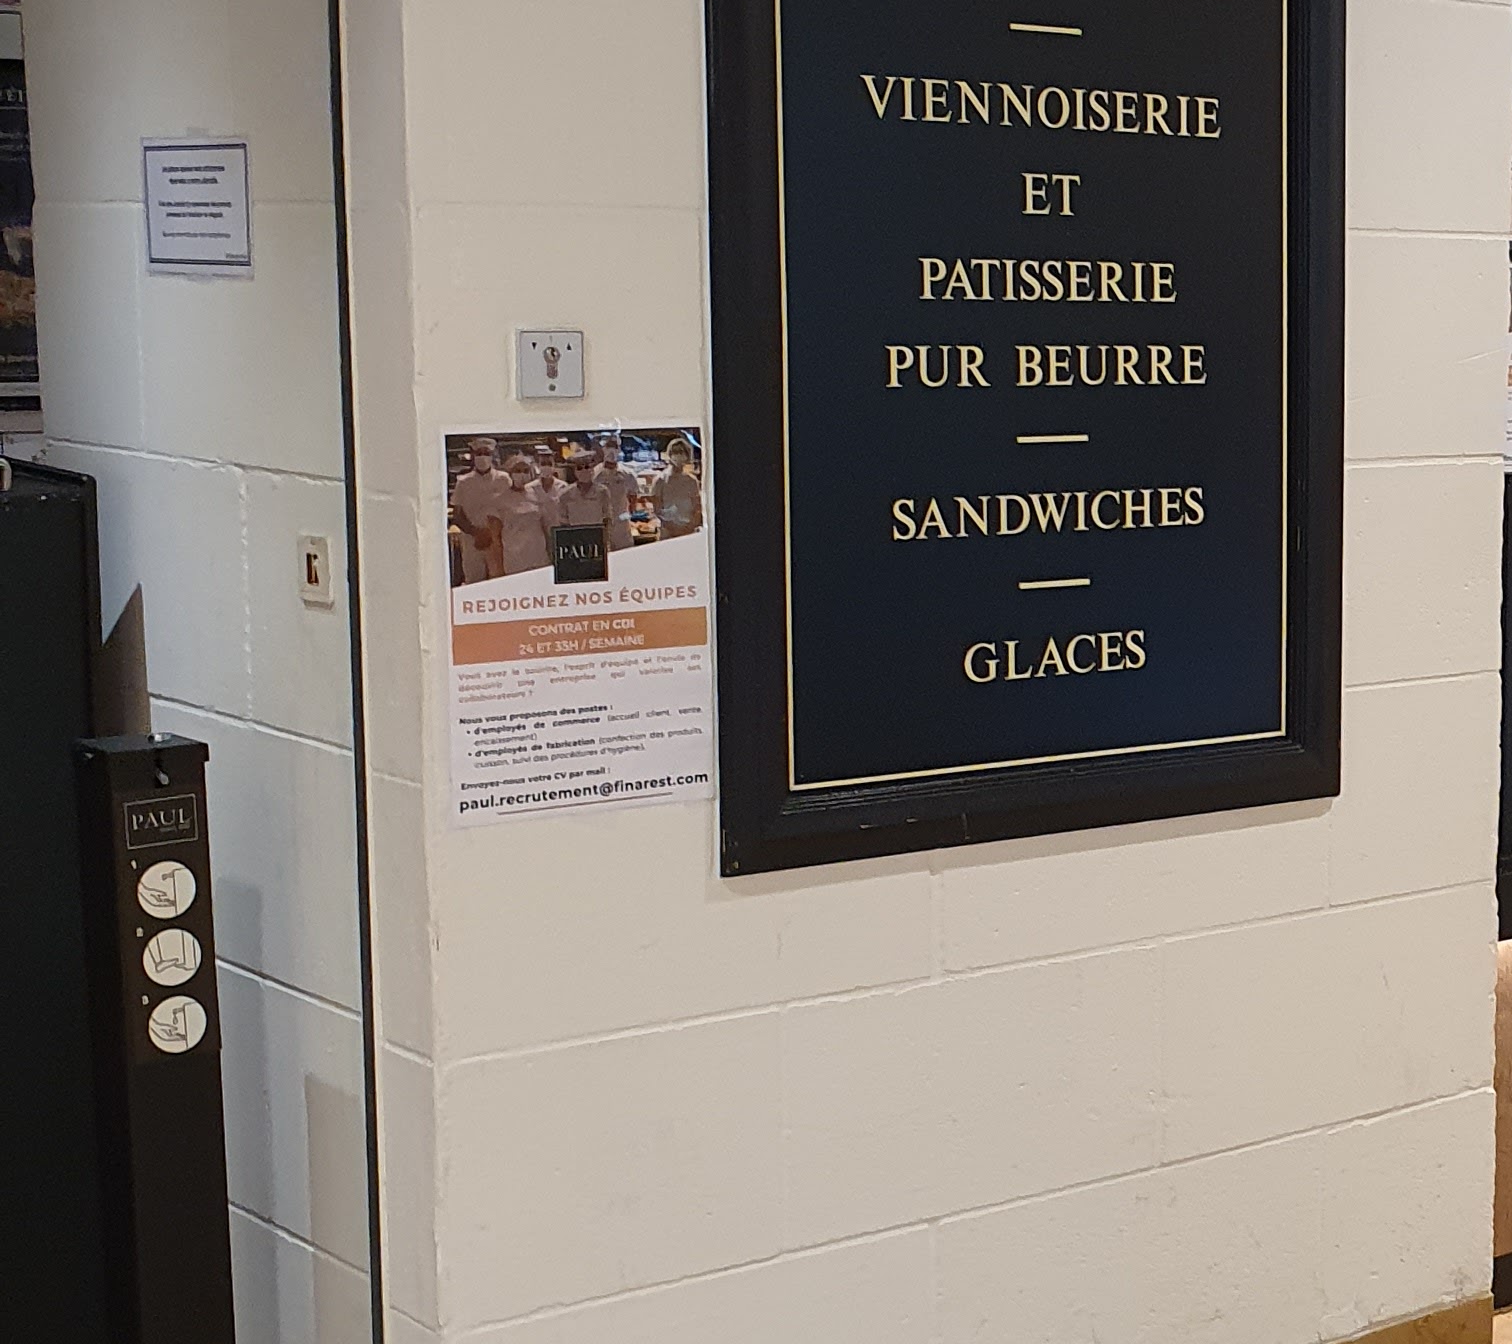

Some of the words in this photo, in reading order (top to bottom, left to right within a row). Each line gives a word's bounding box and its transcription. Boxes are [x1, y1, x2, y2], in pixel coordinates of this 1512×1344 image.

[859, 74, 1222, 139] VIENNOISERIE
[1021, 172, 1081, 216] ET
[918, 257, 1178, 303] PATISSERIE
[884, 345, 992, 388] PUR
[1014, 344, 1208, 387] BEURRE
[892, 486, 1205, 541] SANDWICHES
[559, 544, 603, 560] PAUL
[462, 594, 569, 614] REJOIGNEZ
[575, 591, 613, 605] NOS
[619, 585, 697, 603] ÉQUIPES
[528, 620, 589, 636] CONTRAT
[592, 620, 610, 631] EN
[612, 618, 635, 629] CDI
[536, 642, 551, 653] ET
[588, 634, 645, 649] SEMAINE
[963, 629, 1146, 683] GLACES
[459, 717, 483, 725] Nous
[485, 714, 507, 722] vous
[533, 721, 545, 729] de
[531, 744, 543, 752] de
[528, 773, 552, 783] votre
[554, 771, 567, 780] CV
[569, 769, 584, 780] par
[459, 773, 708, 814] paul.recrutement@finarest.com
[132, 808, 192, 831] PAUL
